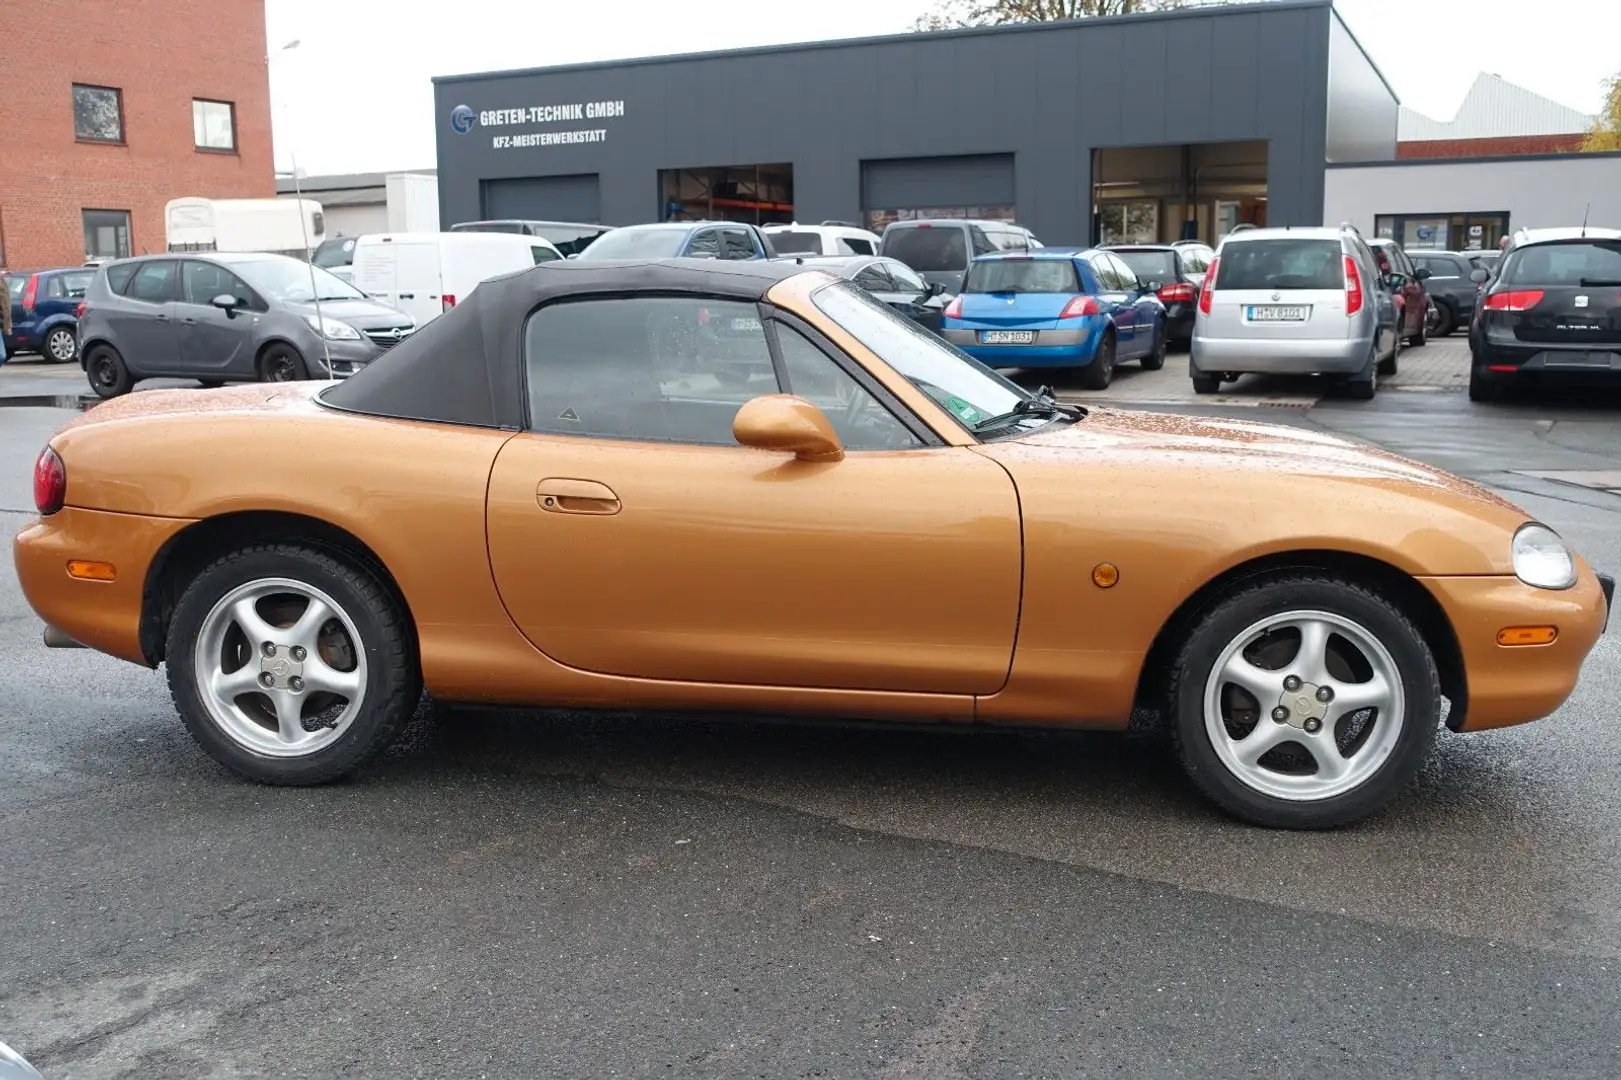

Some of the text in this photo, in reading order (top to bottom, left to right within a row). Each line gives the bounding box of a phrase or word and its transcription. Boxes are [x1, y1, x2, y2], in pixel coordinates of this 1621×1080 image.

[480, 100, 625, 127] GRETEN-TECHNIK GMBH
[493, 129, 607, 149] KFZ-MEISTERWERKSTATT
